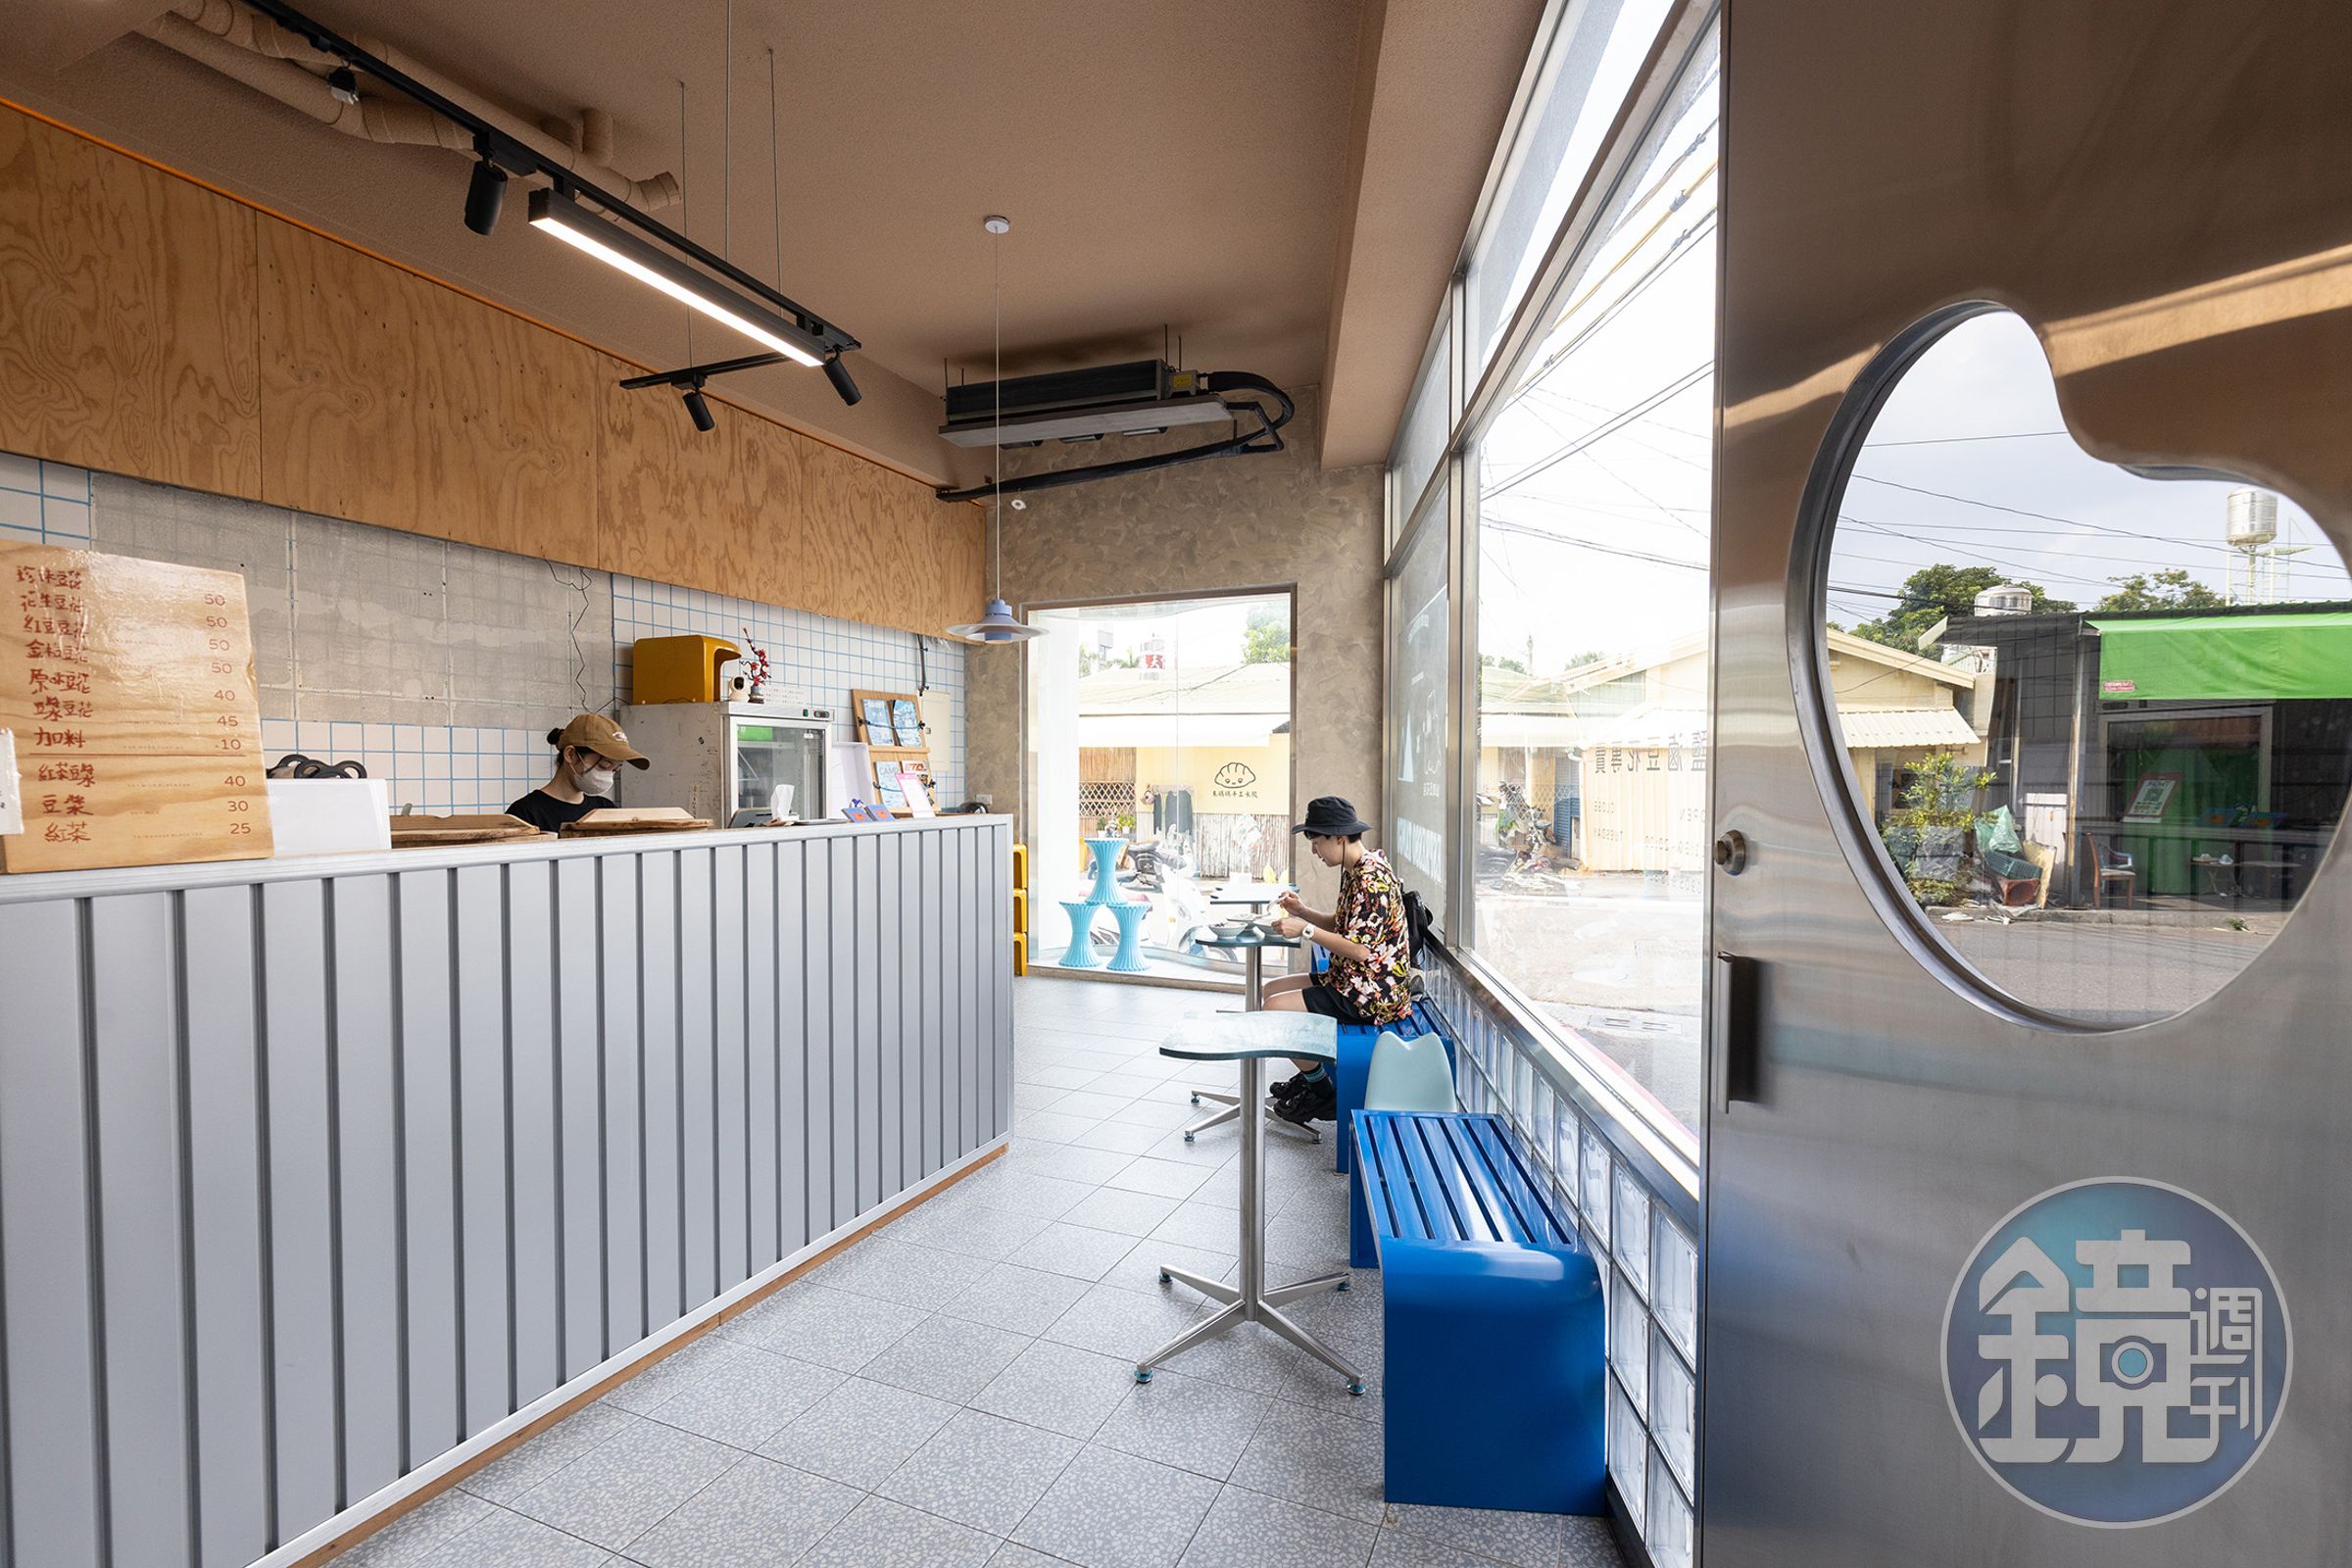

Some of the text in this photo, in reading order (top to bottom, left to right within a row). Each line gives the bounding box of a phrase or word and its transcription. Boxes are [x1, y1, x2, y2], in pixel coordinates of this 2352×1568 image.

[21, 590, 84, 612] 花生豆花
[204, 593, 226, 607] 50
[206, 615, 228, 628] 50
[209, 638, 230, 651] 50
[212, 662, 233, 674] 50
[29, 668, 91, 695] 原味豆花
[214, 689, 236, 702] 40
[217, 715, 239, 727] 45
[34, 726, 85, 748] 加料
[38, 761, 95, 788] 紅茶豆漿
[224, 775, 246, 787] 40
[42, 794, 94, 815] 豆漿
[227, 800, 249, 812] 30
[45, 821, 91, 843] 紅茶
[229, 823, 252, 835] 25
